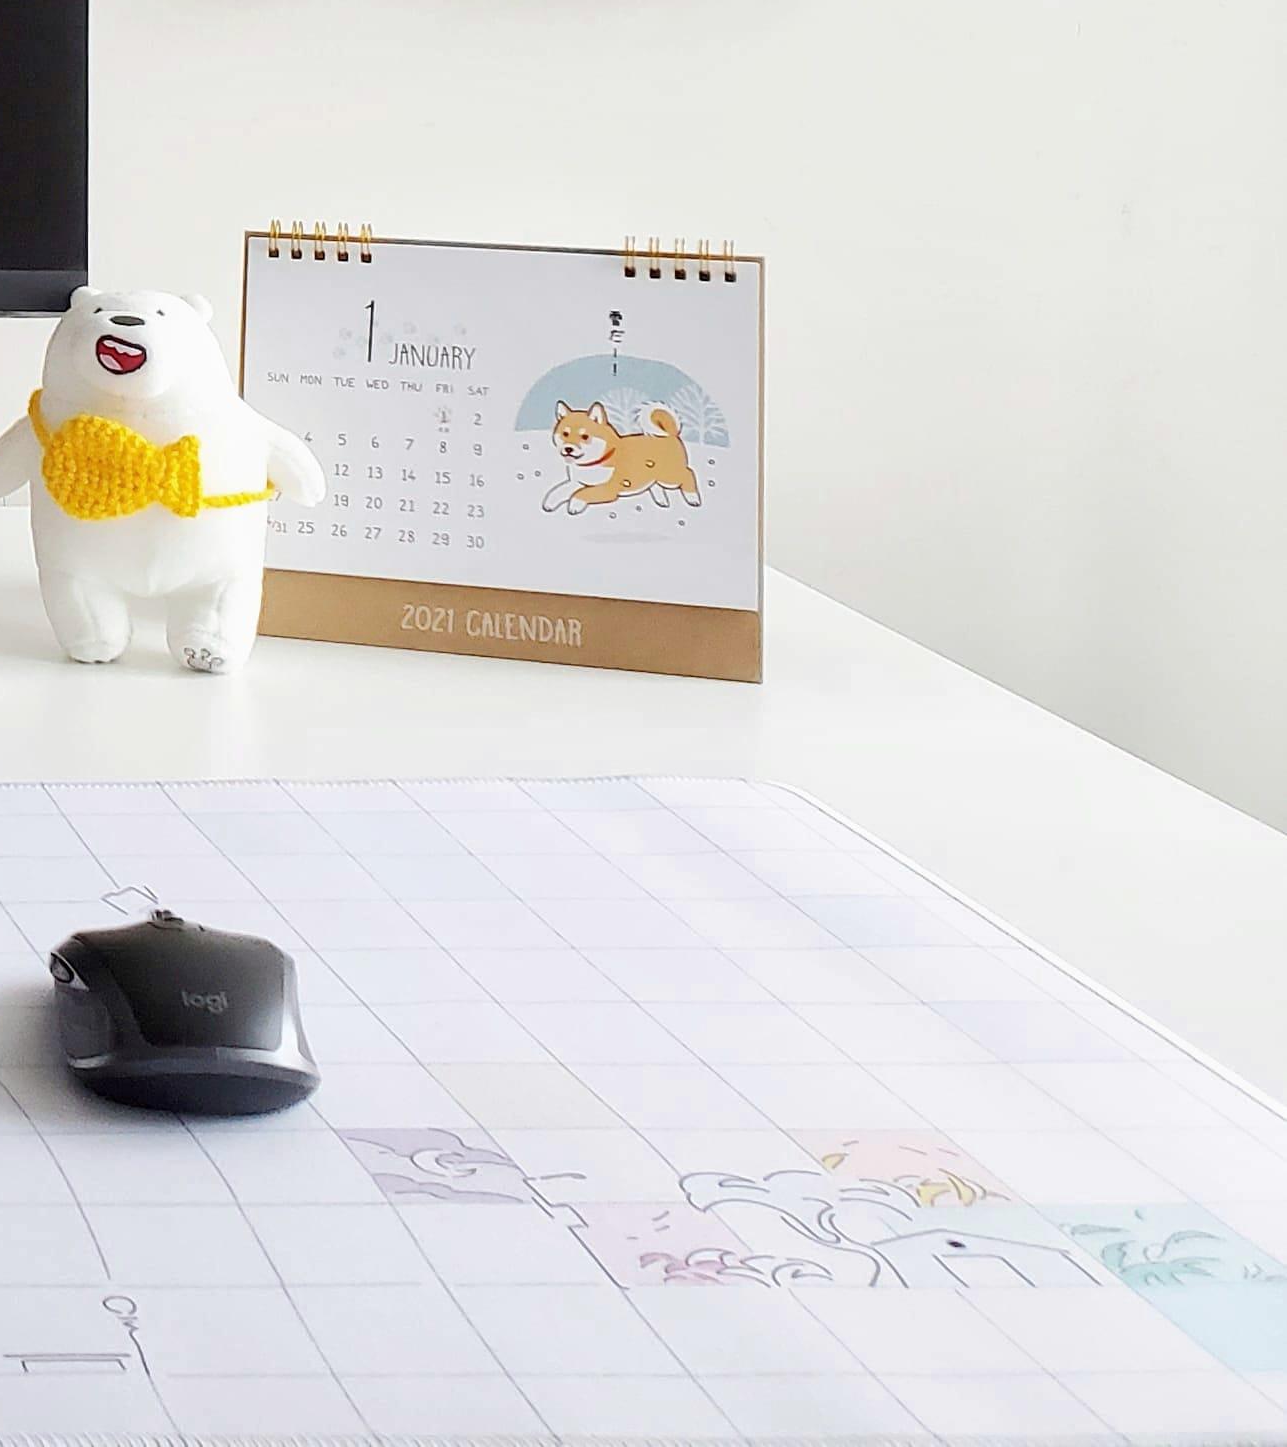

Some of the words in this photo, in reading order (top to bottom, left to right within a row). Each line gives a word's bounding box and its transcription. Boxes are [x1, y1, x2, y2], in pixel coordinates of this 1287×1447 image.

[364, 300, 375, 362] 1
[388, 343, 476, 370] JANUARY
[267, 371, 289, 384] SUN
[300, 374, 322, 385] MON
[334, 376, 356, 388] TUE
[366, 379, 390, 390] WED
[400, 381, 423, 393] THU
[435, 383, 454, 394] FRI
[467, 386, 490, 397] SAT
[473, 413, 483, 426] 2
[338, 433, 347, 446] 5
[371, 436, 380, 449] 6
[405, 438, 414, 451] 7
[439, 441, 447, 454] 8
[473, 444, 483, 456] 9
[334, 463, 349, 477] 12
[367, 466, 383, 479] 13
[402, 468, 416, 481] 14
[434, 471, 451, 484] 15
[469, 474, 485, 488] 16
[334, 494, 349, 507] 19
[365, 496, 383, 509] 20
[399, 499, 415, 512] 21
[433, 502, 449, 515] 22
[467, 504, 485, 518] 23
[298, 521, 314, 534] 25
[331, 524, 348, 537] 26
[364, 527, 381, 540] 27
[398, 530, 415, 543] 28
[432, 533, 450, 546] 29
[466, 535, 484, 549] 30
[401, 604, 455, 633] 2021
[466, 610, 582, 647] CALENDAR
[181, 990, 228, 1014] logi
